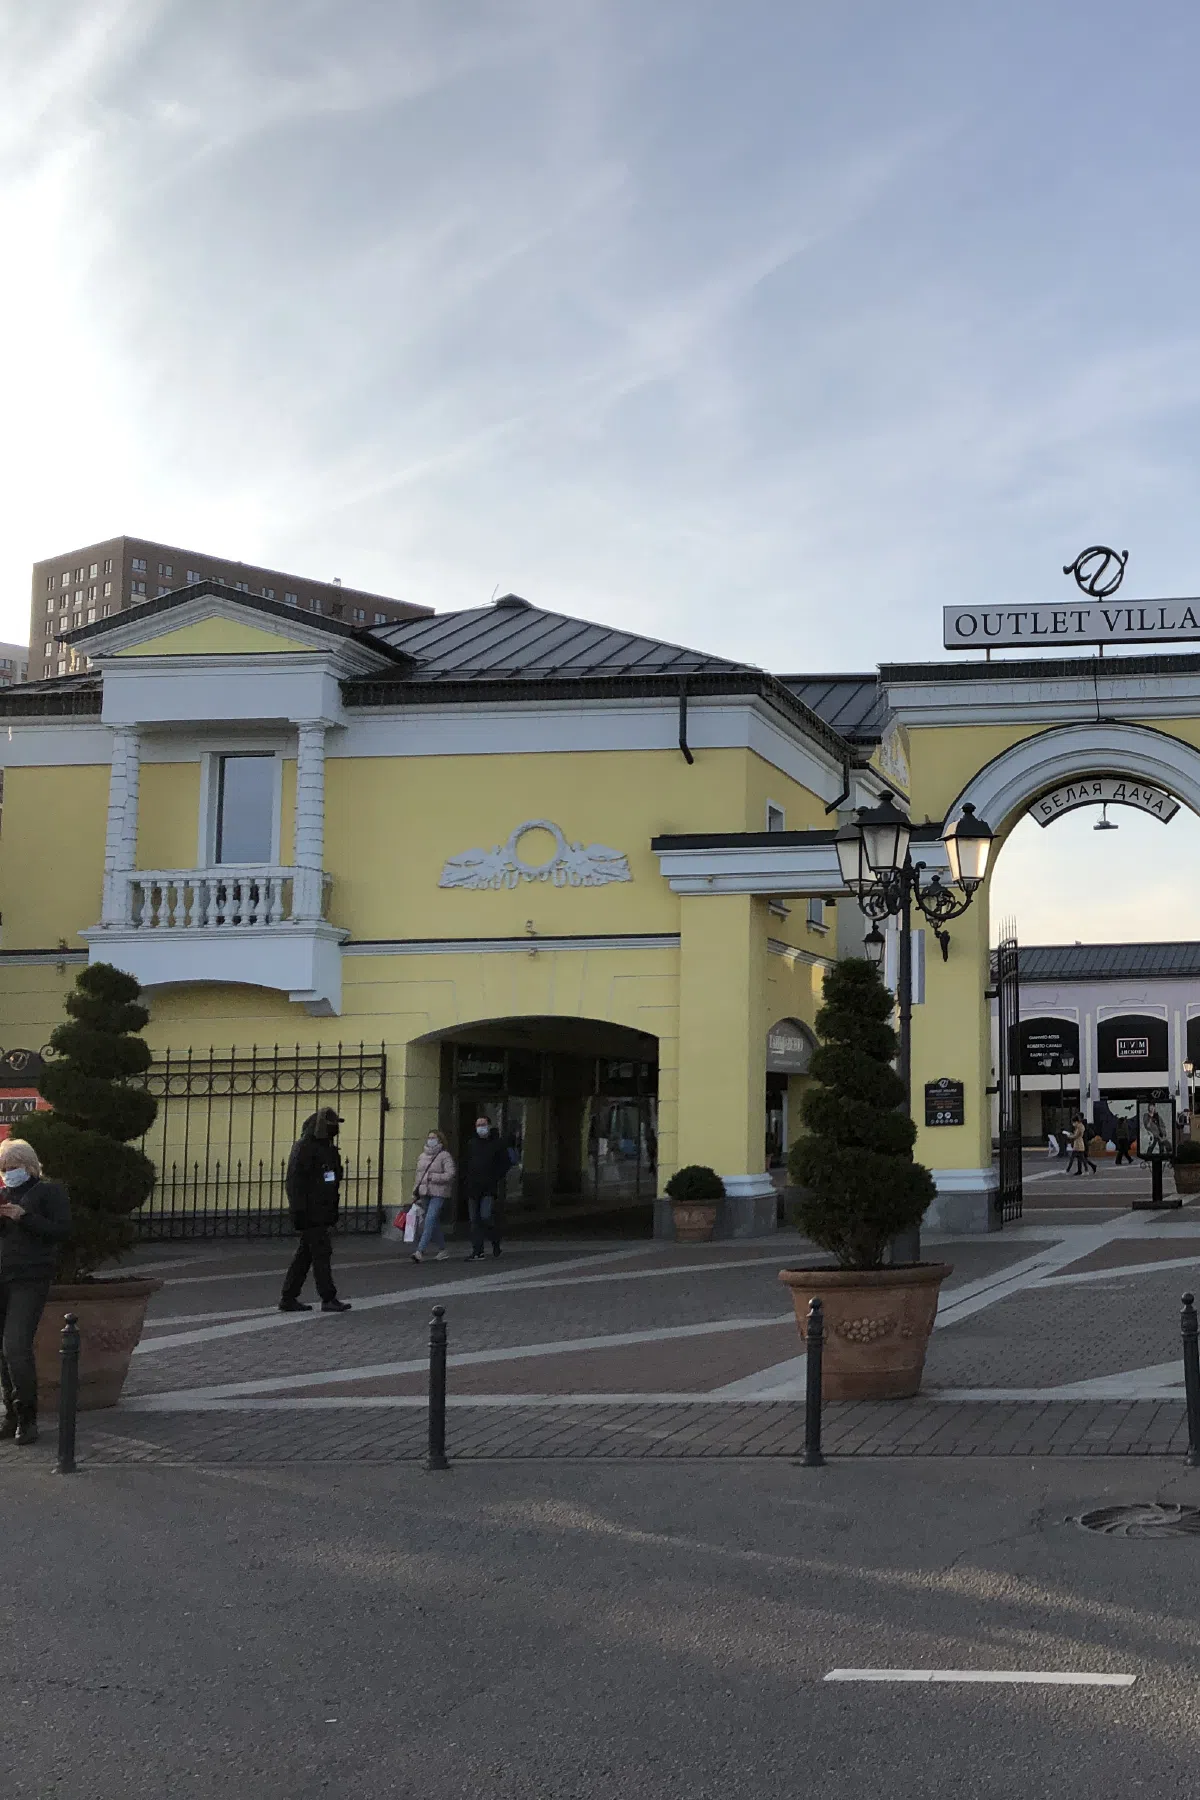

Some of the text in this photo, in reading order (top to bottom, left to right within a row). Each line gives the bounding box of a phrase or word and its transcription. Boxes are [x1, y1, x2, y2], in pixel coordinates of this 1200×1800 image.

[954, 609, 1091, 638] OUTLET
[1039, 782, 1165, 816] БЕЛАЯ ДАЧА
